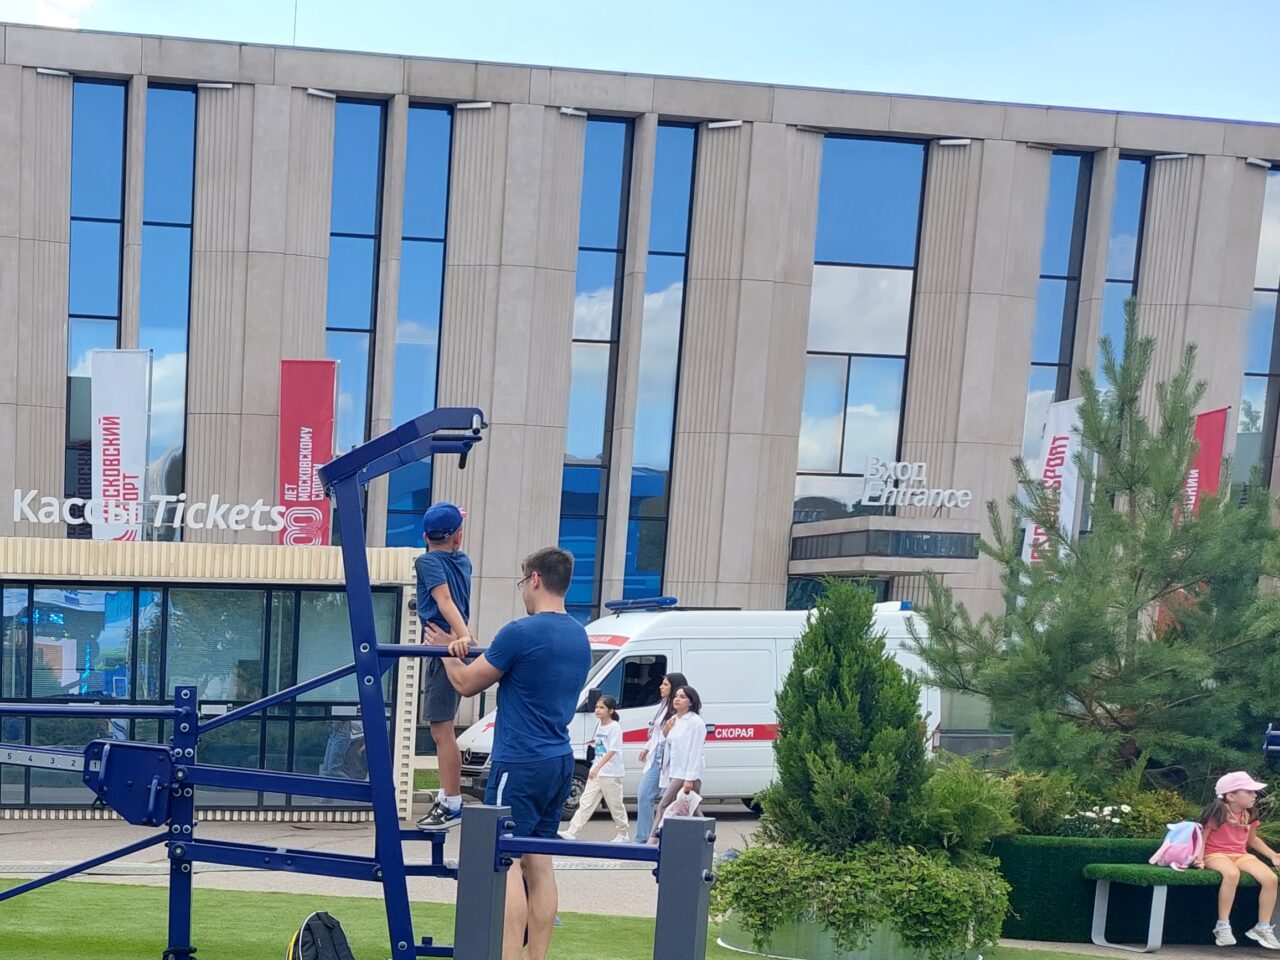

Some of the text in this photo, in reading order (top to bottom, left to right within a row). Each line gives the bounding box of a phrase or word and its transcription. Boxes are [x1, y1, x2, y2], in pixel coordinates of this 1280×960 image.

[98, 416, 120, 523] СКОВСКИЙ
[298, 426, 313, 501] МОСКОВСКОМУ
[866, 456, 927, 487] Вход
[1042, 436, 1070, 490] SPORT
[284, 483, 298, 501] ЛЕТ
[861, 480, 972, 508] Entrance
[13, 489, 287, 532] Кассы Tickets
[715, 728, 754, 738] СКОРАЯ
[7, 752, 12, 760] 5
[27, 754, 33, 762] 4
[71, 759, 76, 767] 2
[93, 761, 97, 769] 1
